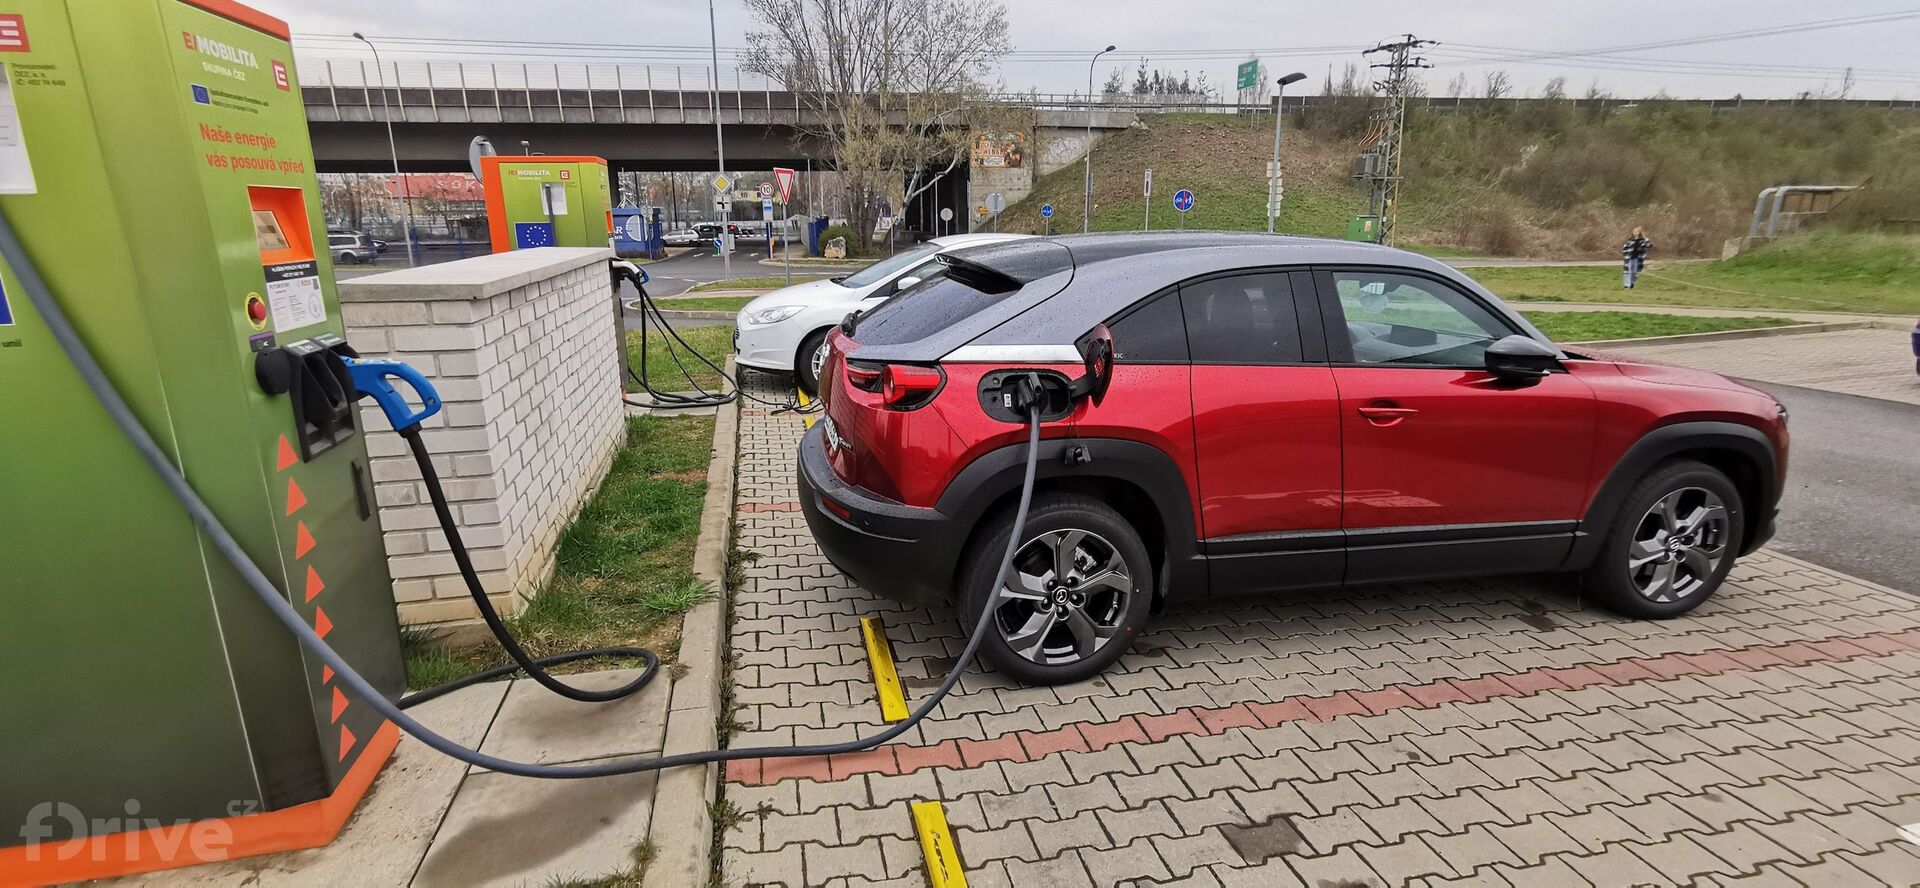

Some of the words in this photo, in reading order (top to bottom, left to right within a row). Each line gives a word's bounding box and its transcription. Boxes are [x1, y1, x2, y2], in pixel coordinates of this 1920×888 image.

[199, 122, 232, 144] Naše
[234, 132, 277, 151] energie
[206, 150, 228, 169] vás
[231, 155, 277, 173] posouvá
[278, 158, 305, 175] vpřed
[763, 186, 771, 194] 10
